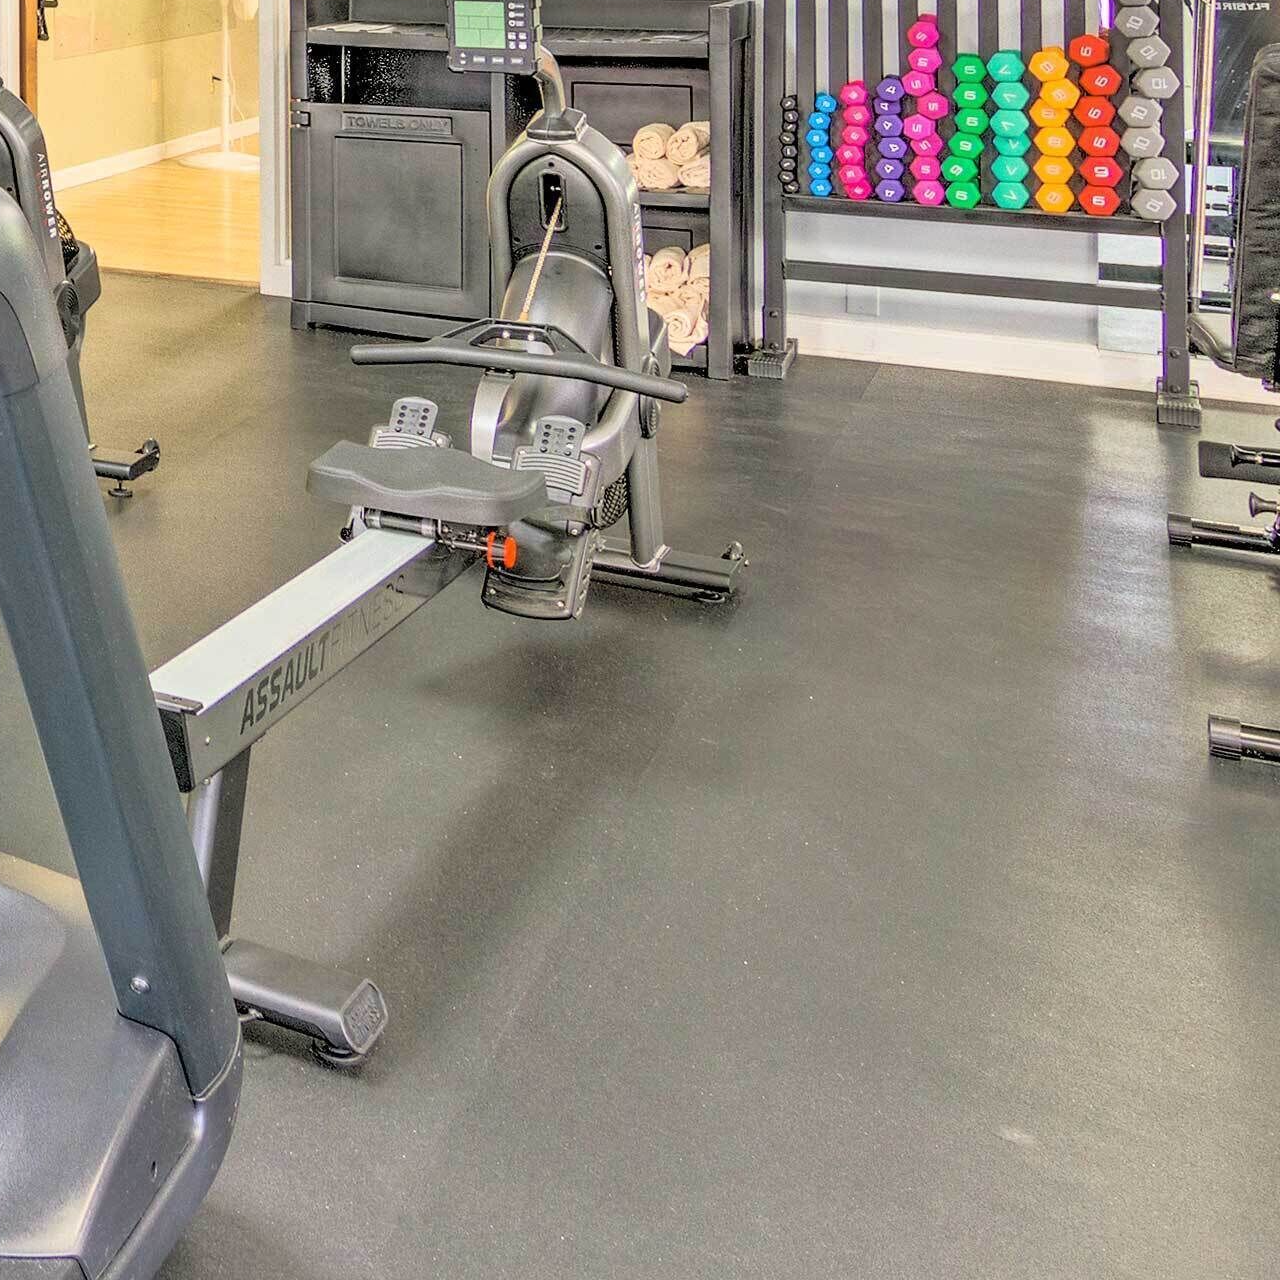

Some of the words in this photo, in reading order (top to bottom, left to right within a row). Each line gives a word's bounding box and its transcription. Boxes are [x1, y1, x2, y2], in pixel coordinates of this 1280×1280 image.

[1126, 15, 1143, 31] 10
[1140, 45, 1158, 60] 10
[1151, 77, 1168, 90] 10
[886, 86, 897, 95] 4
[880, 102, 889, 111] 4
[1130, 105, 1148, 120] 10
[347, 115, 406, 130] TOWELS
[882, 120, 892, 130] 4
[889, 143, 900, 152] 4
[1133, 136, 1150, 151] 10
[884, 164, 894, 173] 4
[1150, 169, 1167, 181] 10
[885, 189, 895, 198] 4
[1146, 198, 1164, 212] 10
[240, 631, 330, 735] ASSAULT
